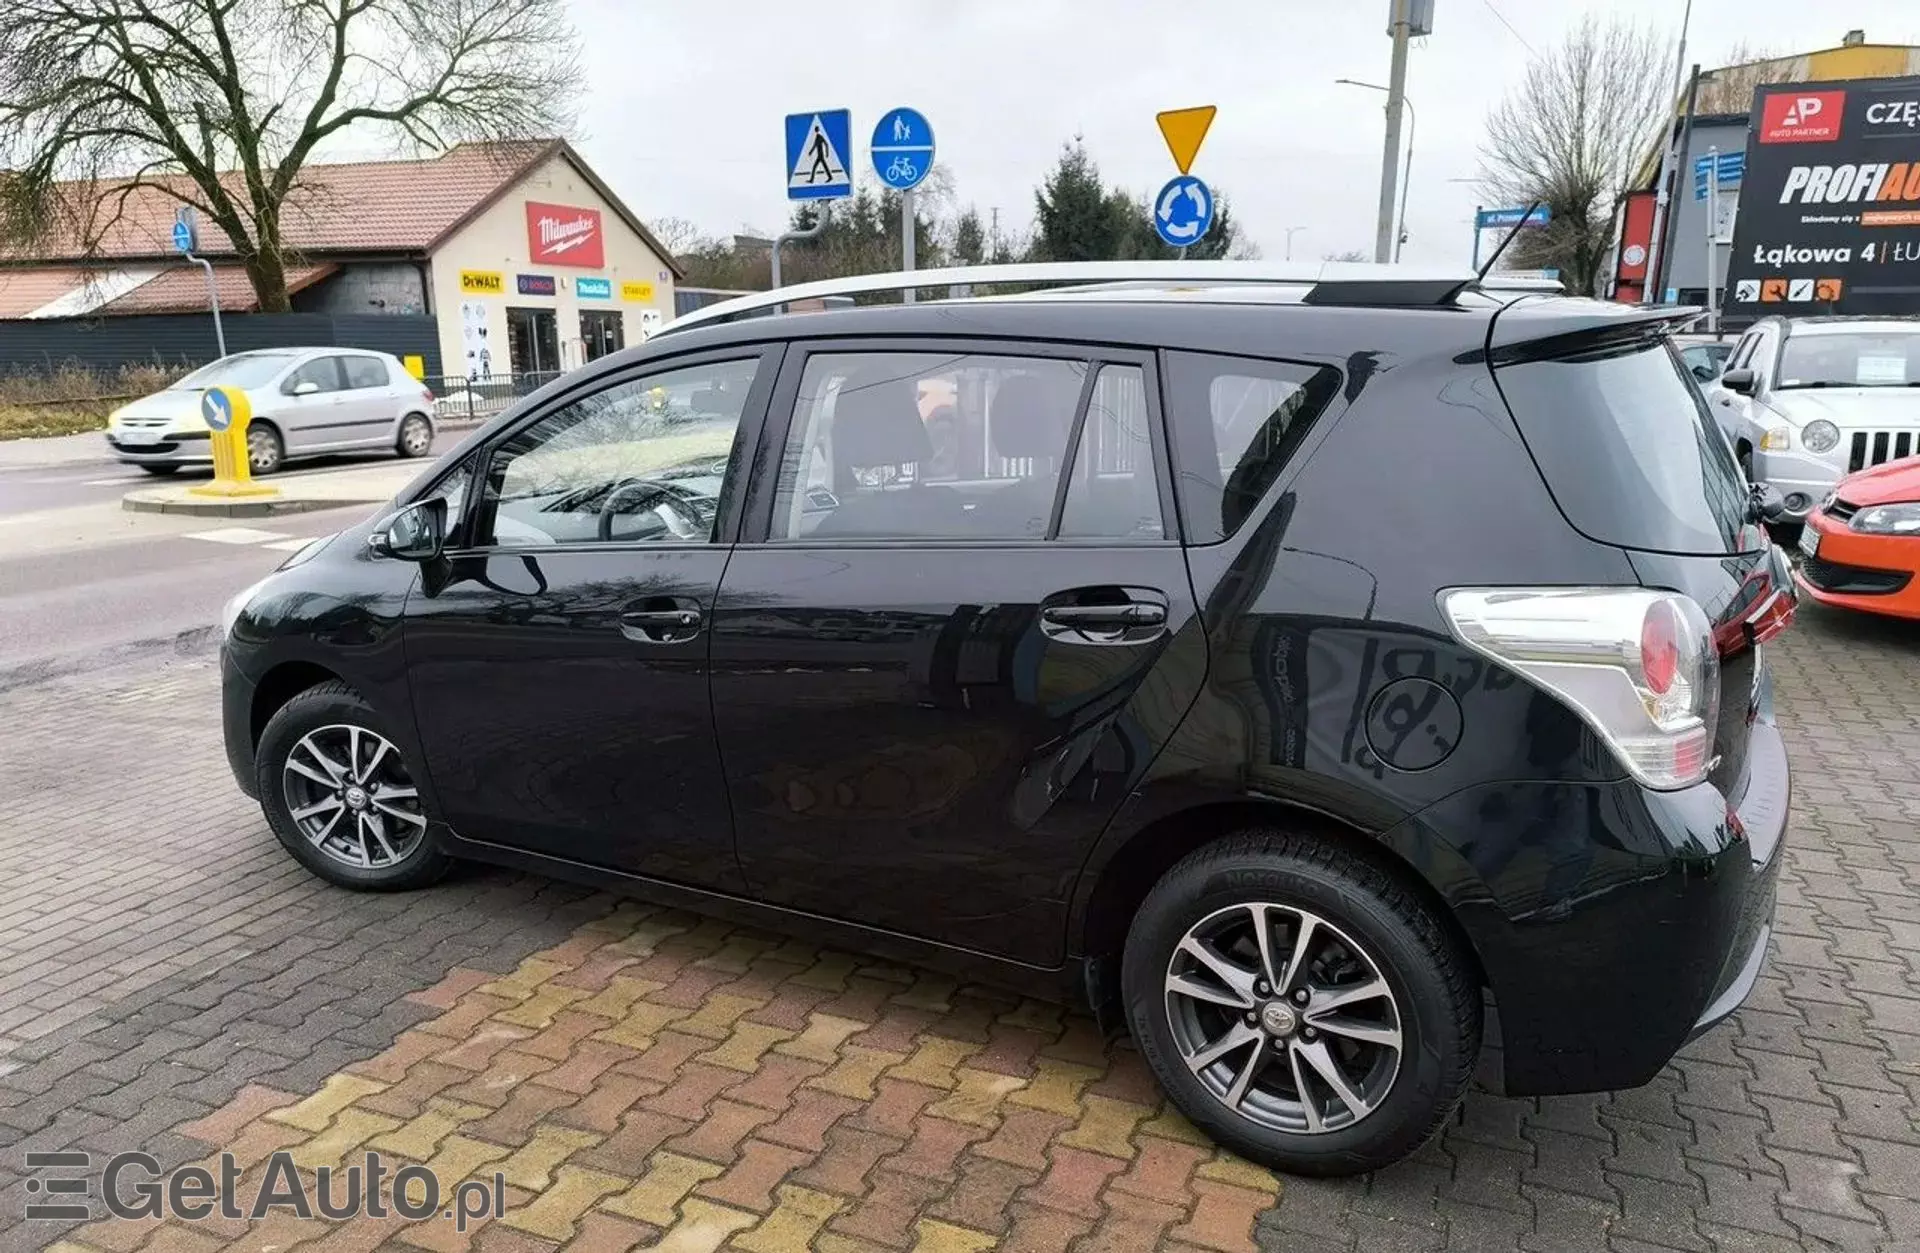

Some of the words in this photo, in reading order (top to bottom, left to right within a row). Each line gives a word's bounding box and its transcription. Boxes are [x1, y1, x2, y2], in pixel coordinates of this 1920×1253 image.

[1866, 101, 1920, 127] CZĘ
[1792, 127, 1830, 137] PARTNER
[537, 213, 594, 246] Milwaukee
[1753, 243, 1852, 268] Łąkowa
[1860, 241, 1877, 262] 4
[623, 285, 651, 297] STANLEY
